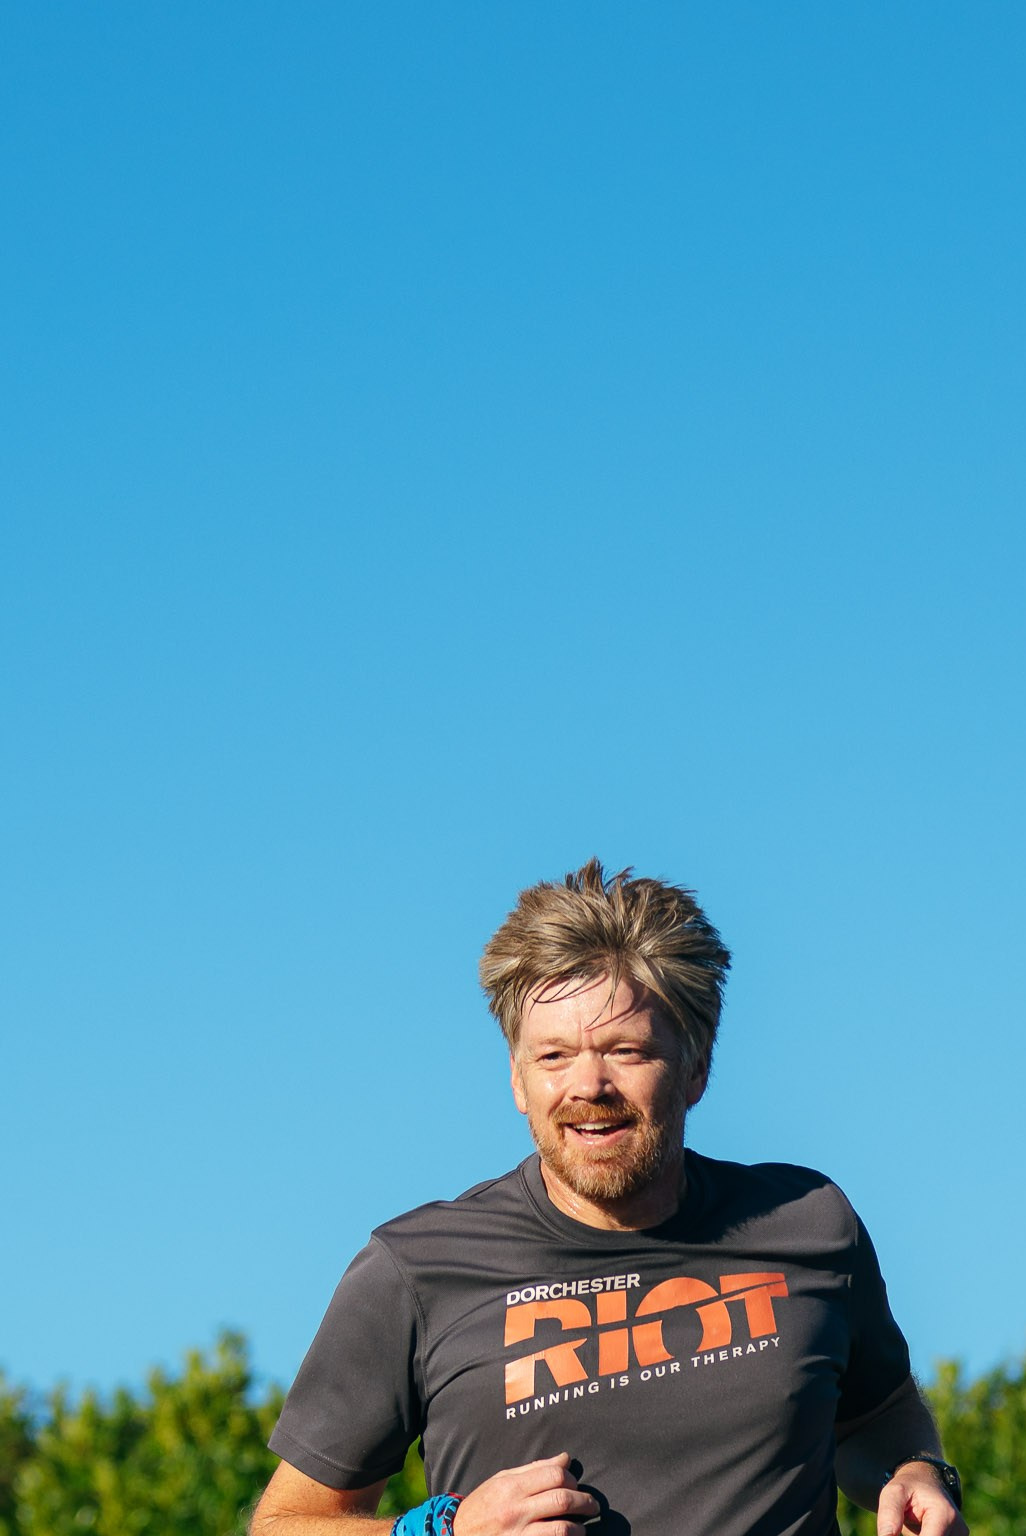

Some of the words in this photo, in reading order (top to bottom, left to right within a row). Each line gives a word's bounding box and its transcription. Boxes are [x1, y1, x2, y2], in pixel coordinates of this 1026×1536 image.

[506, 1273, 641, 1305] DORCHESTER
[506, 1381, 599, 1420] RUNNING
[611, 1375, 629, 1389] IS
[640, 1362, 681, 1382] OUR
[691, 1337, 781, 1368] THERAPY
